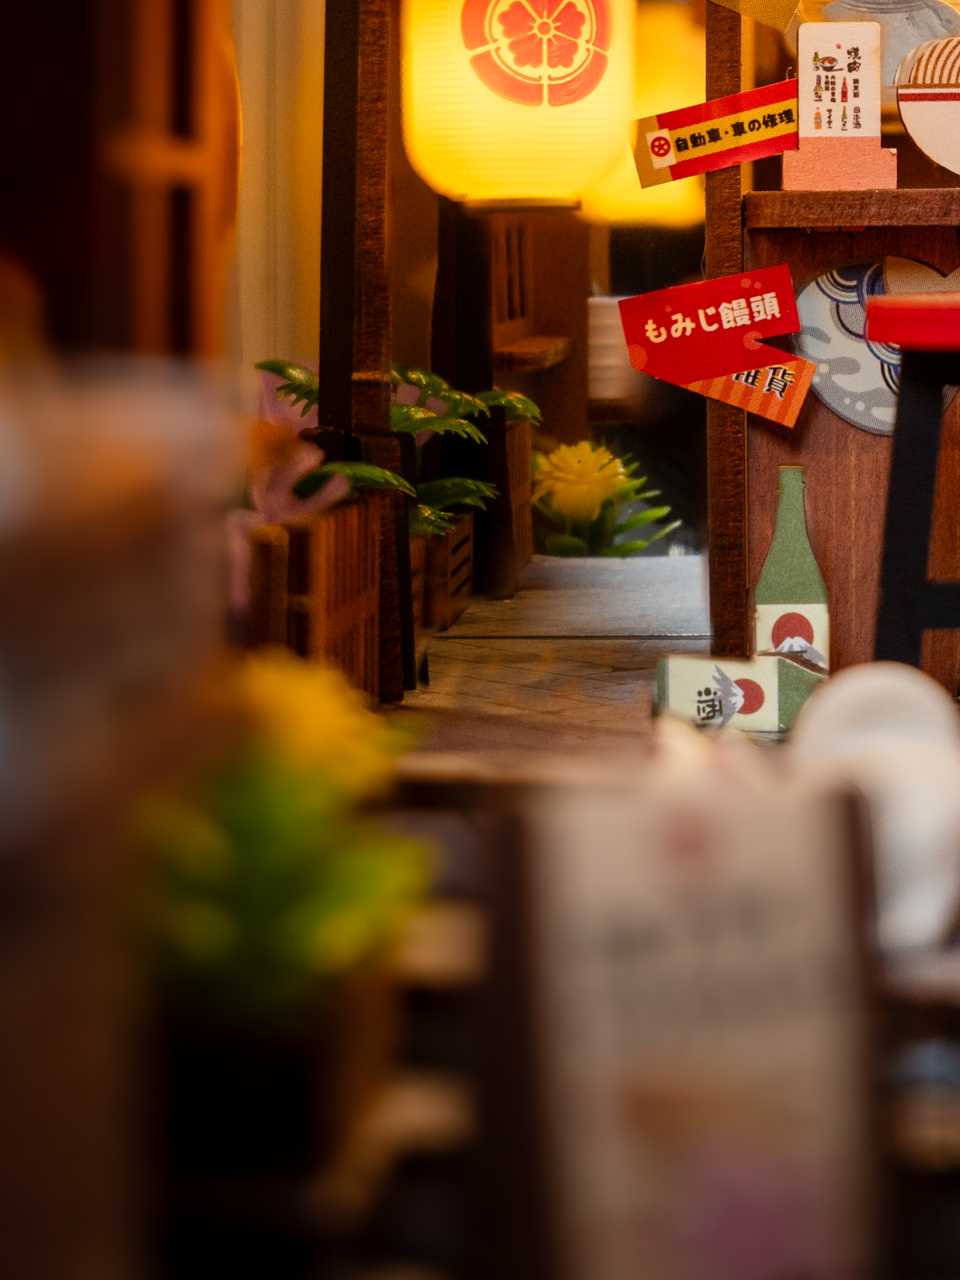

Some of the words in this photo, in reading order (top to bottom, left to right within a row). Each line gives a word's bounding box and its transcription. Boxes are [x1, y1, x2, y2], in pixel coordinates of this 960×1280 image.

[644, 291, 782, 344] もみじ饅頭
